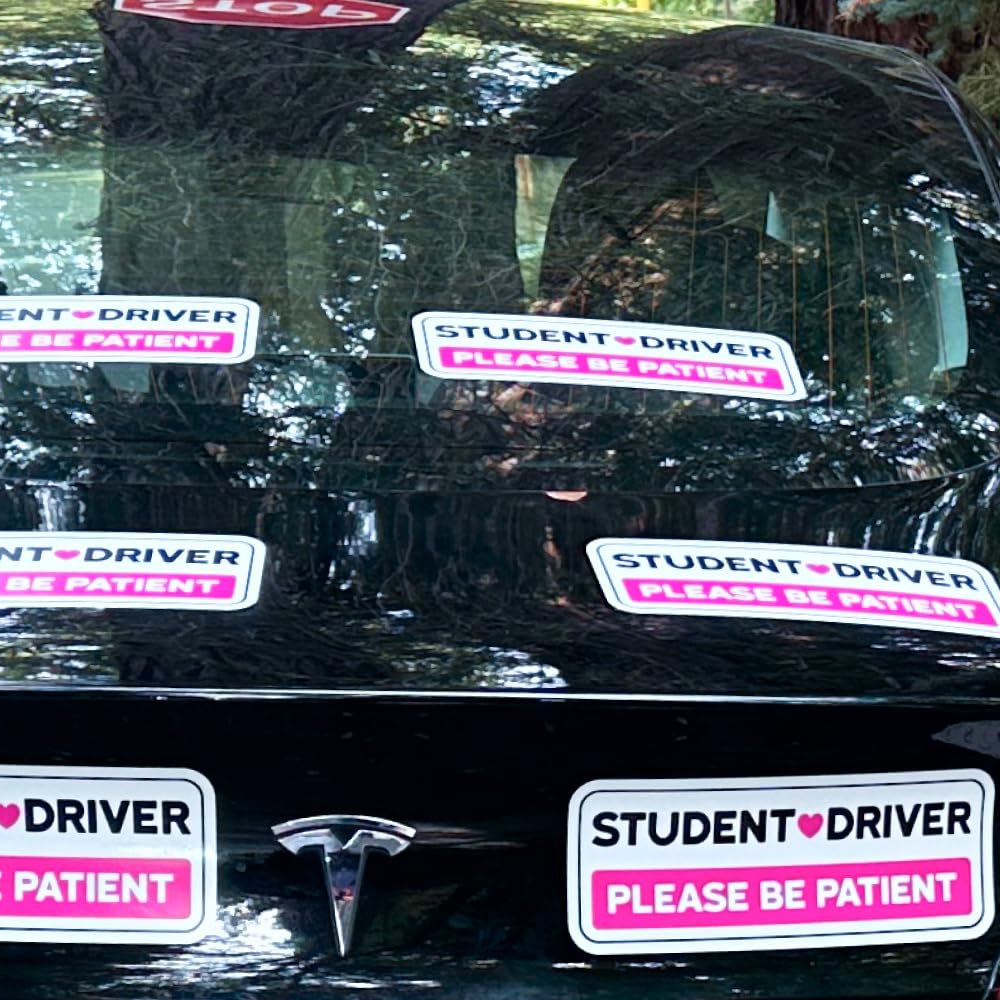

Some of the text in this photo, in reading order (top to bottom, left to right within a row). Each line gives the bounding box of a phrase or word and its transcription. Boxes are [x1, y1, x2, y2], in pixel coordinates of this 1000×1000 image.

[98, 308, 237, 324] DRIVER
[30, 333, 74, 347] BE
[83, 333, 221, 349] PATIENT
[435, 325, 775, 360] STUDENT DRIVER
[453, 351, 768, 384] PLEASE BE PATIENT
[83, 547, 240, 566] DRIVER
[612, 553, 979, 591] STUDENT DRIVER
[5, 576, 54, 593] BE
[66, 577, 220, 595] PATIENT
[639, 584, 977, 619] PLEASE BE PATIENT
[23, 798, 192, 835] DRIVER
[591, 801, 972, 848] STUDENT DRIVER
[14, 870, 175, 904] PATIENT
[607, 871, 958, 915] PLEASE BE PATIENT
